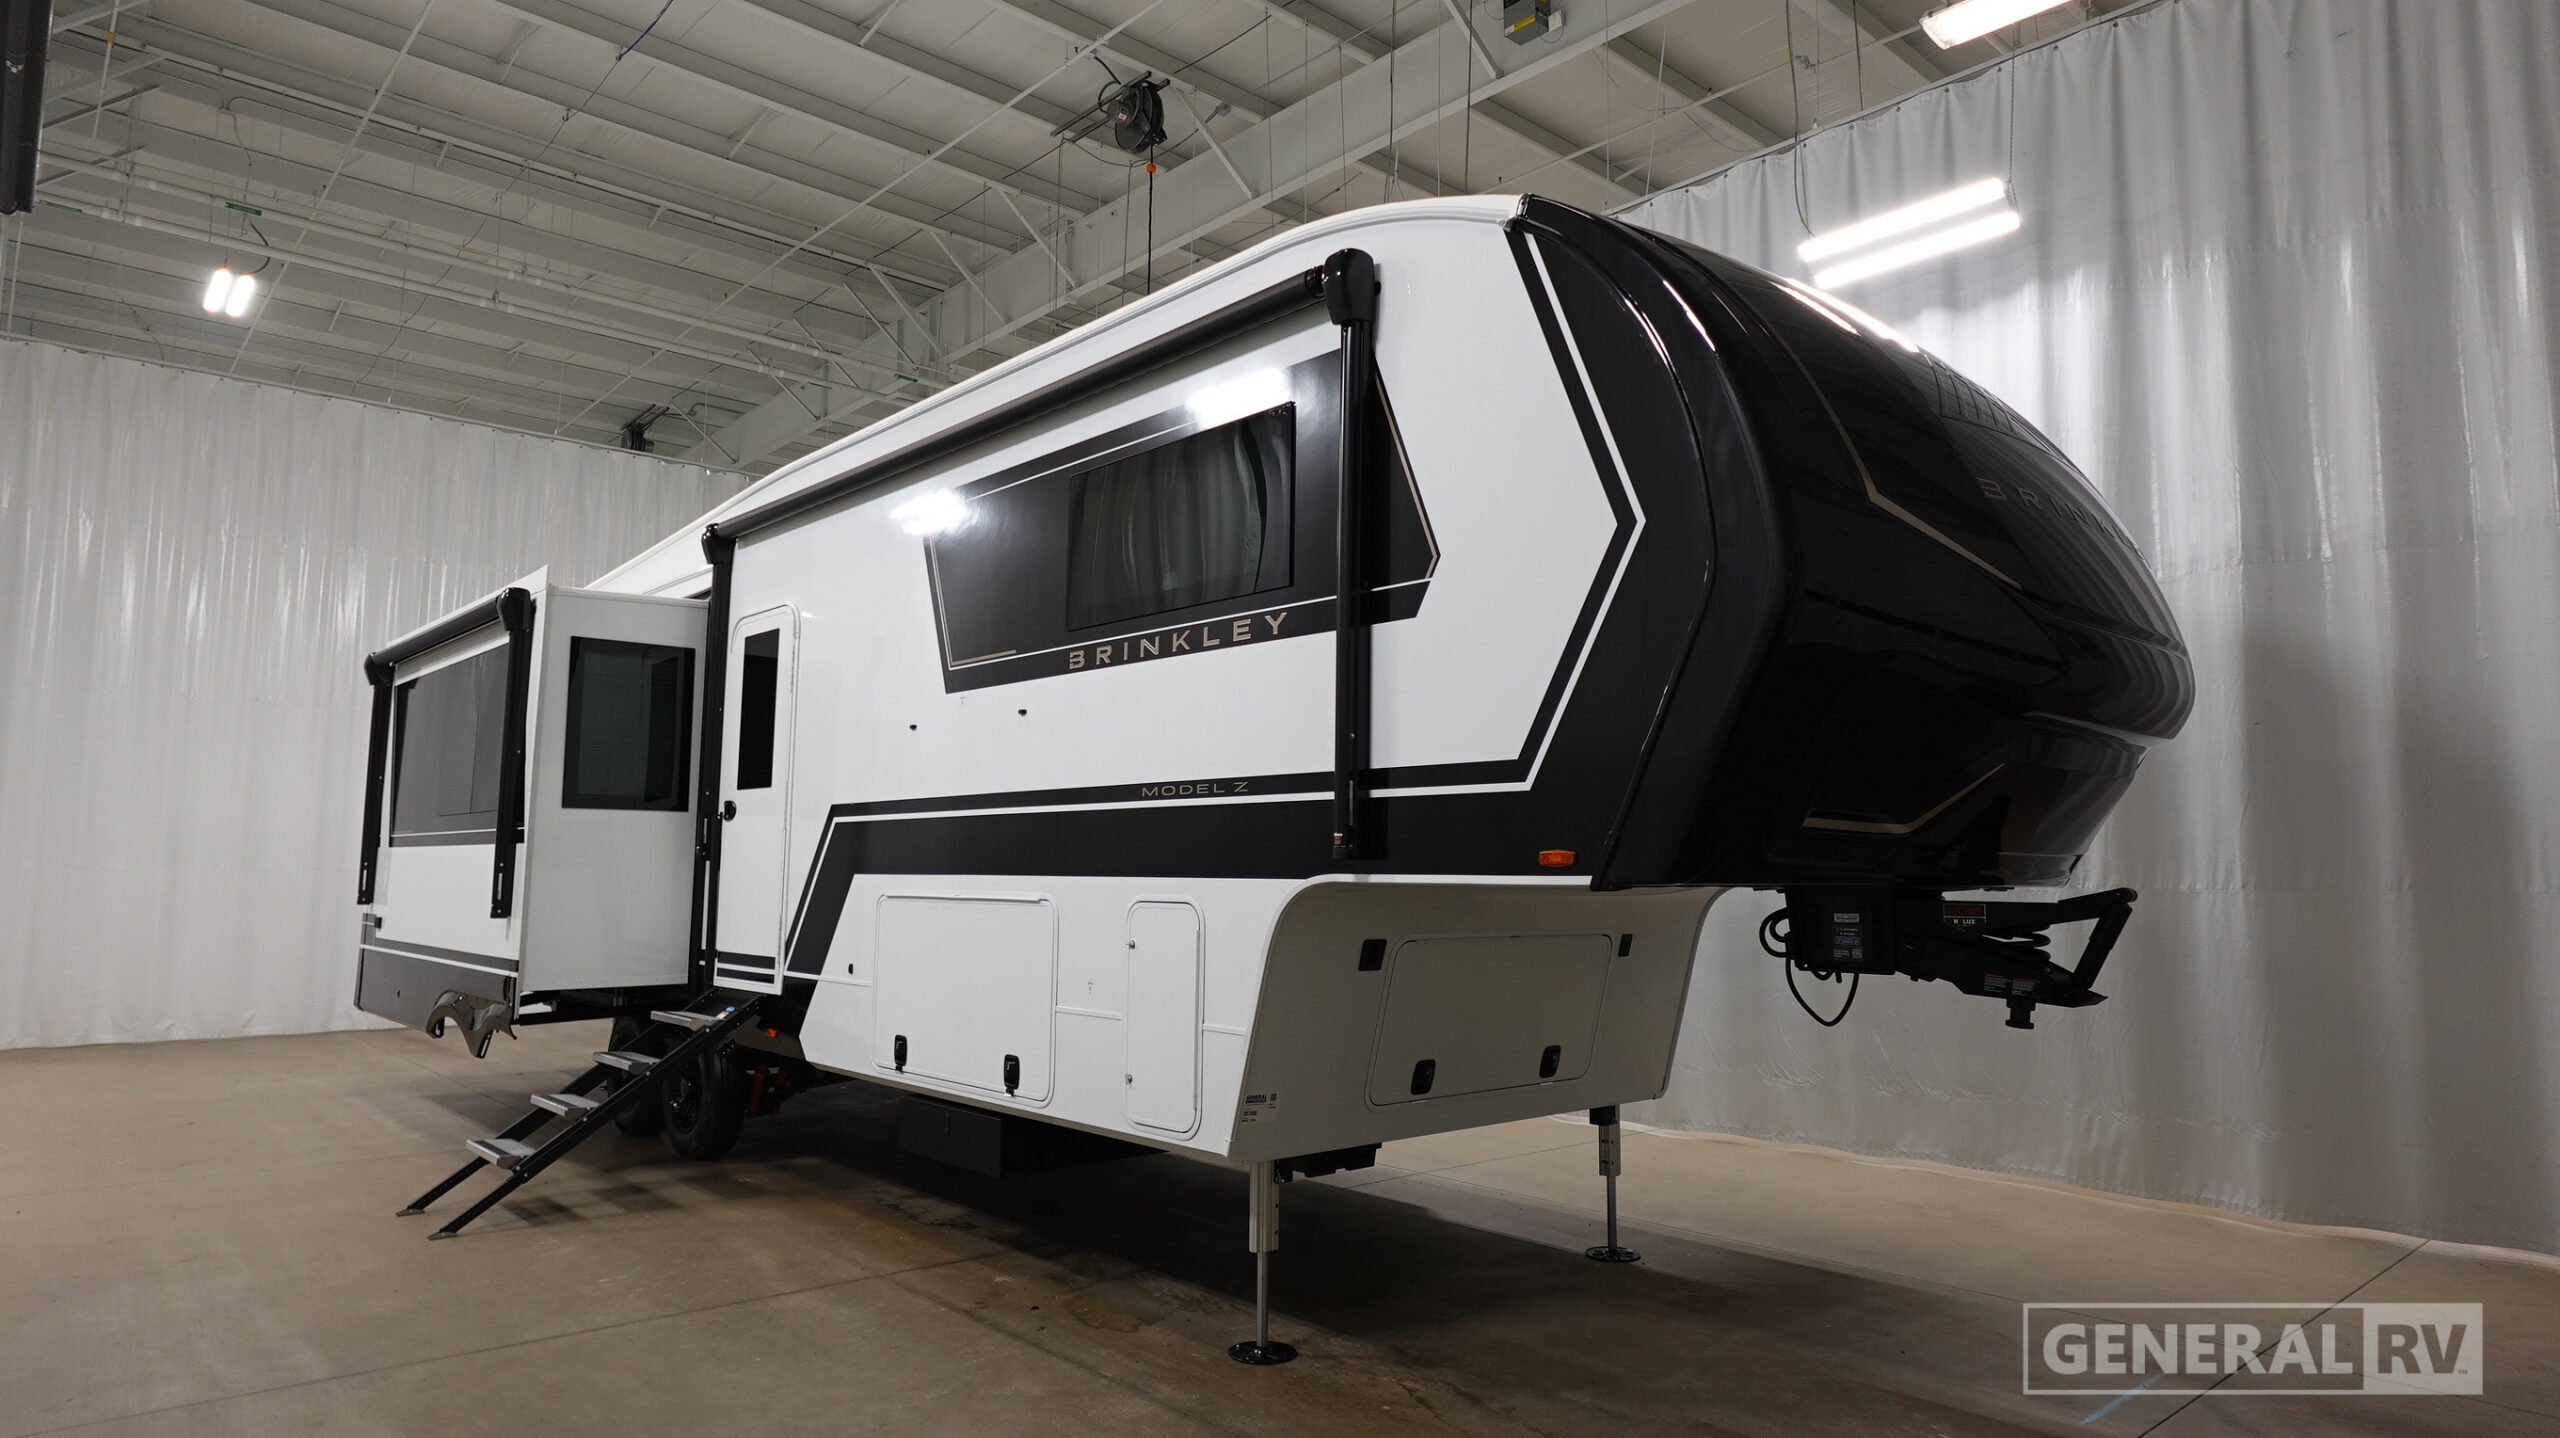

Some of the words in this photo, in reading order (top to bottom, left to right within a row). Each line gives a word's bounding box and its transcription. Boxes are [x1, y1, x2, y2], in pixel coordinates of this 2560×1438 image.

[1068, 612, 1288, 670] BRINKLEY
[1141, 783, 1225, 797] MODEL
[1234, 781, 1249, 793] Z
